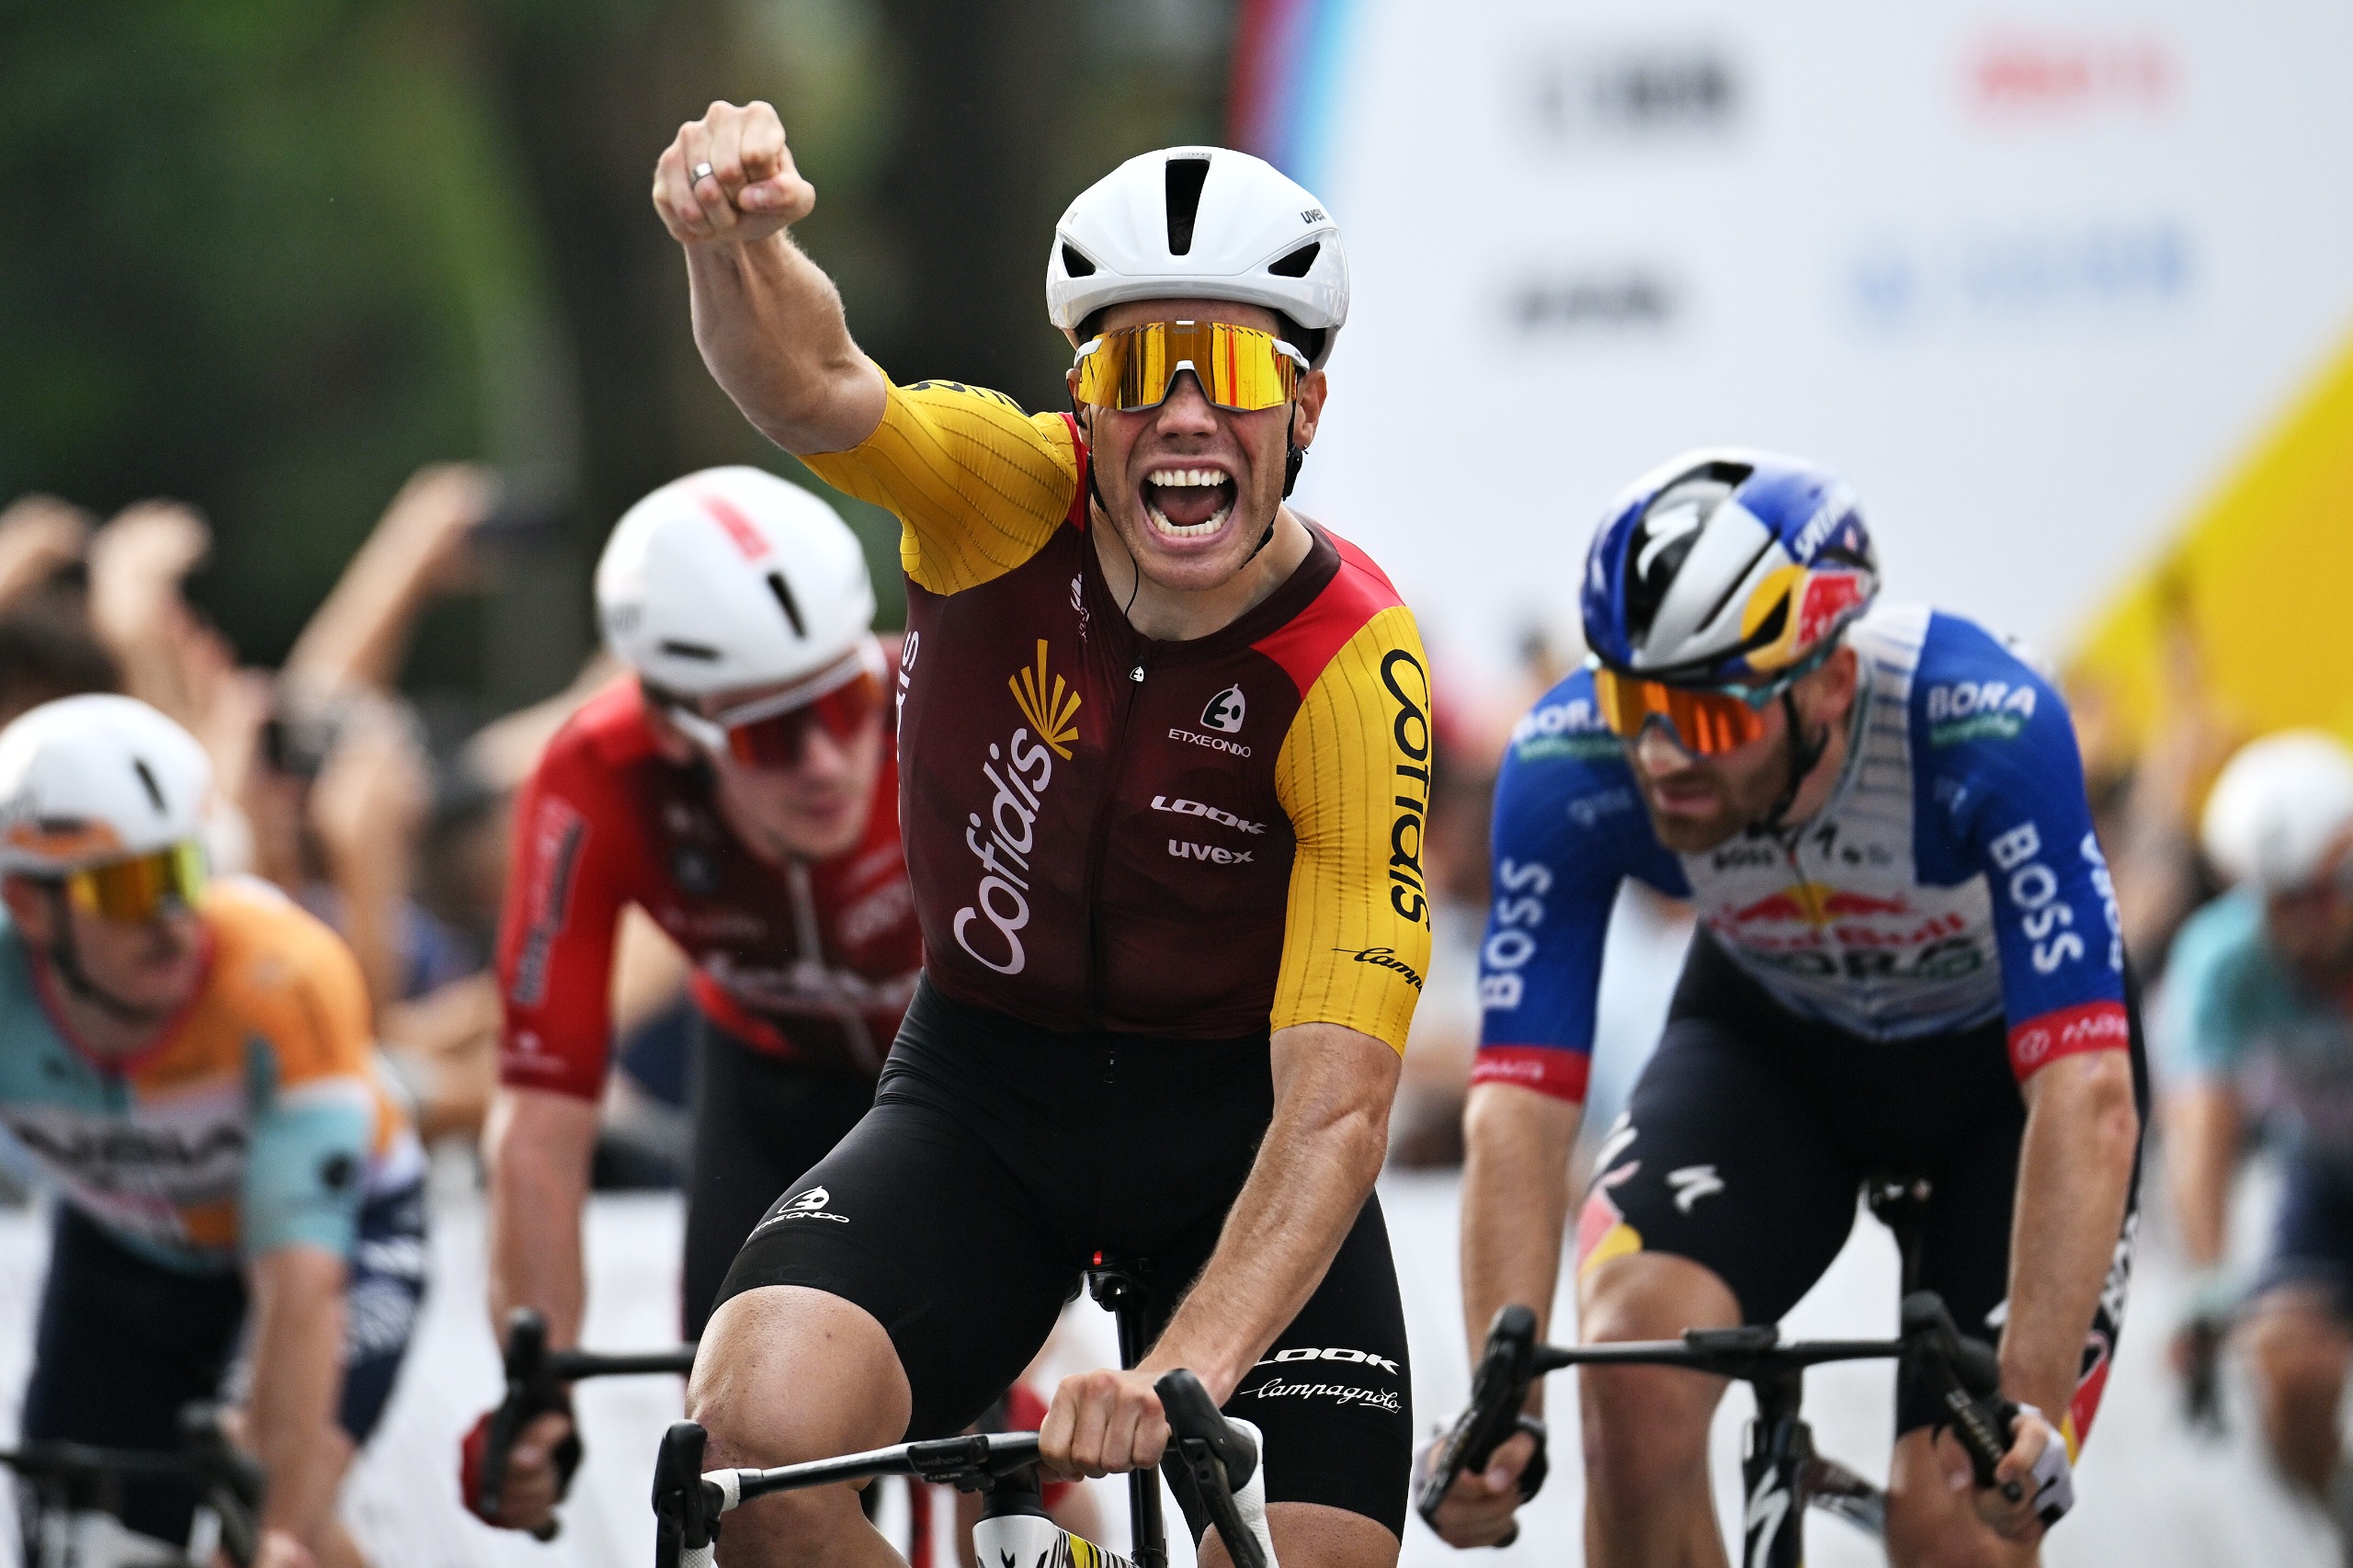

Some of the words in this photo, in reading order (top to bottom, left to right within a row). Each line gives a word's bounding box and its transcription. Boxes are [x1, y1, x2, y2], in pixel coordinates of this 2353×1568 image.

[1927, 681, 2037, 721] BORA
[1168, 729, 1251, 757] ETXEONDO
[1151, 795, 1267, 835] LOOK
[953, 728, 1052, 975] Cofidis
[1168, 839, 1255, 864] uvex
[1989, 820, 2085, 974] BOSS
[1481, 858, 1553, 1008] BOSS
[1331, 948, 1422, 994] Camp
[1239, 1378, 1403, 1414] Campagnolo
